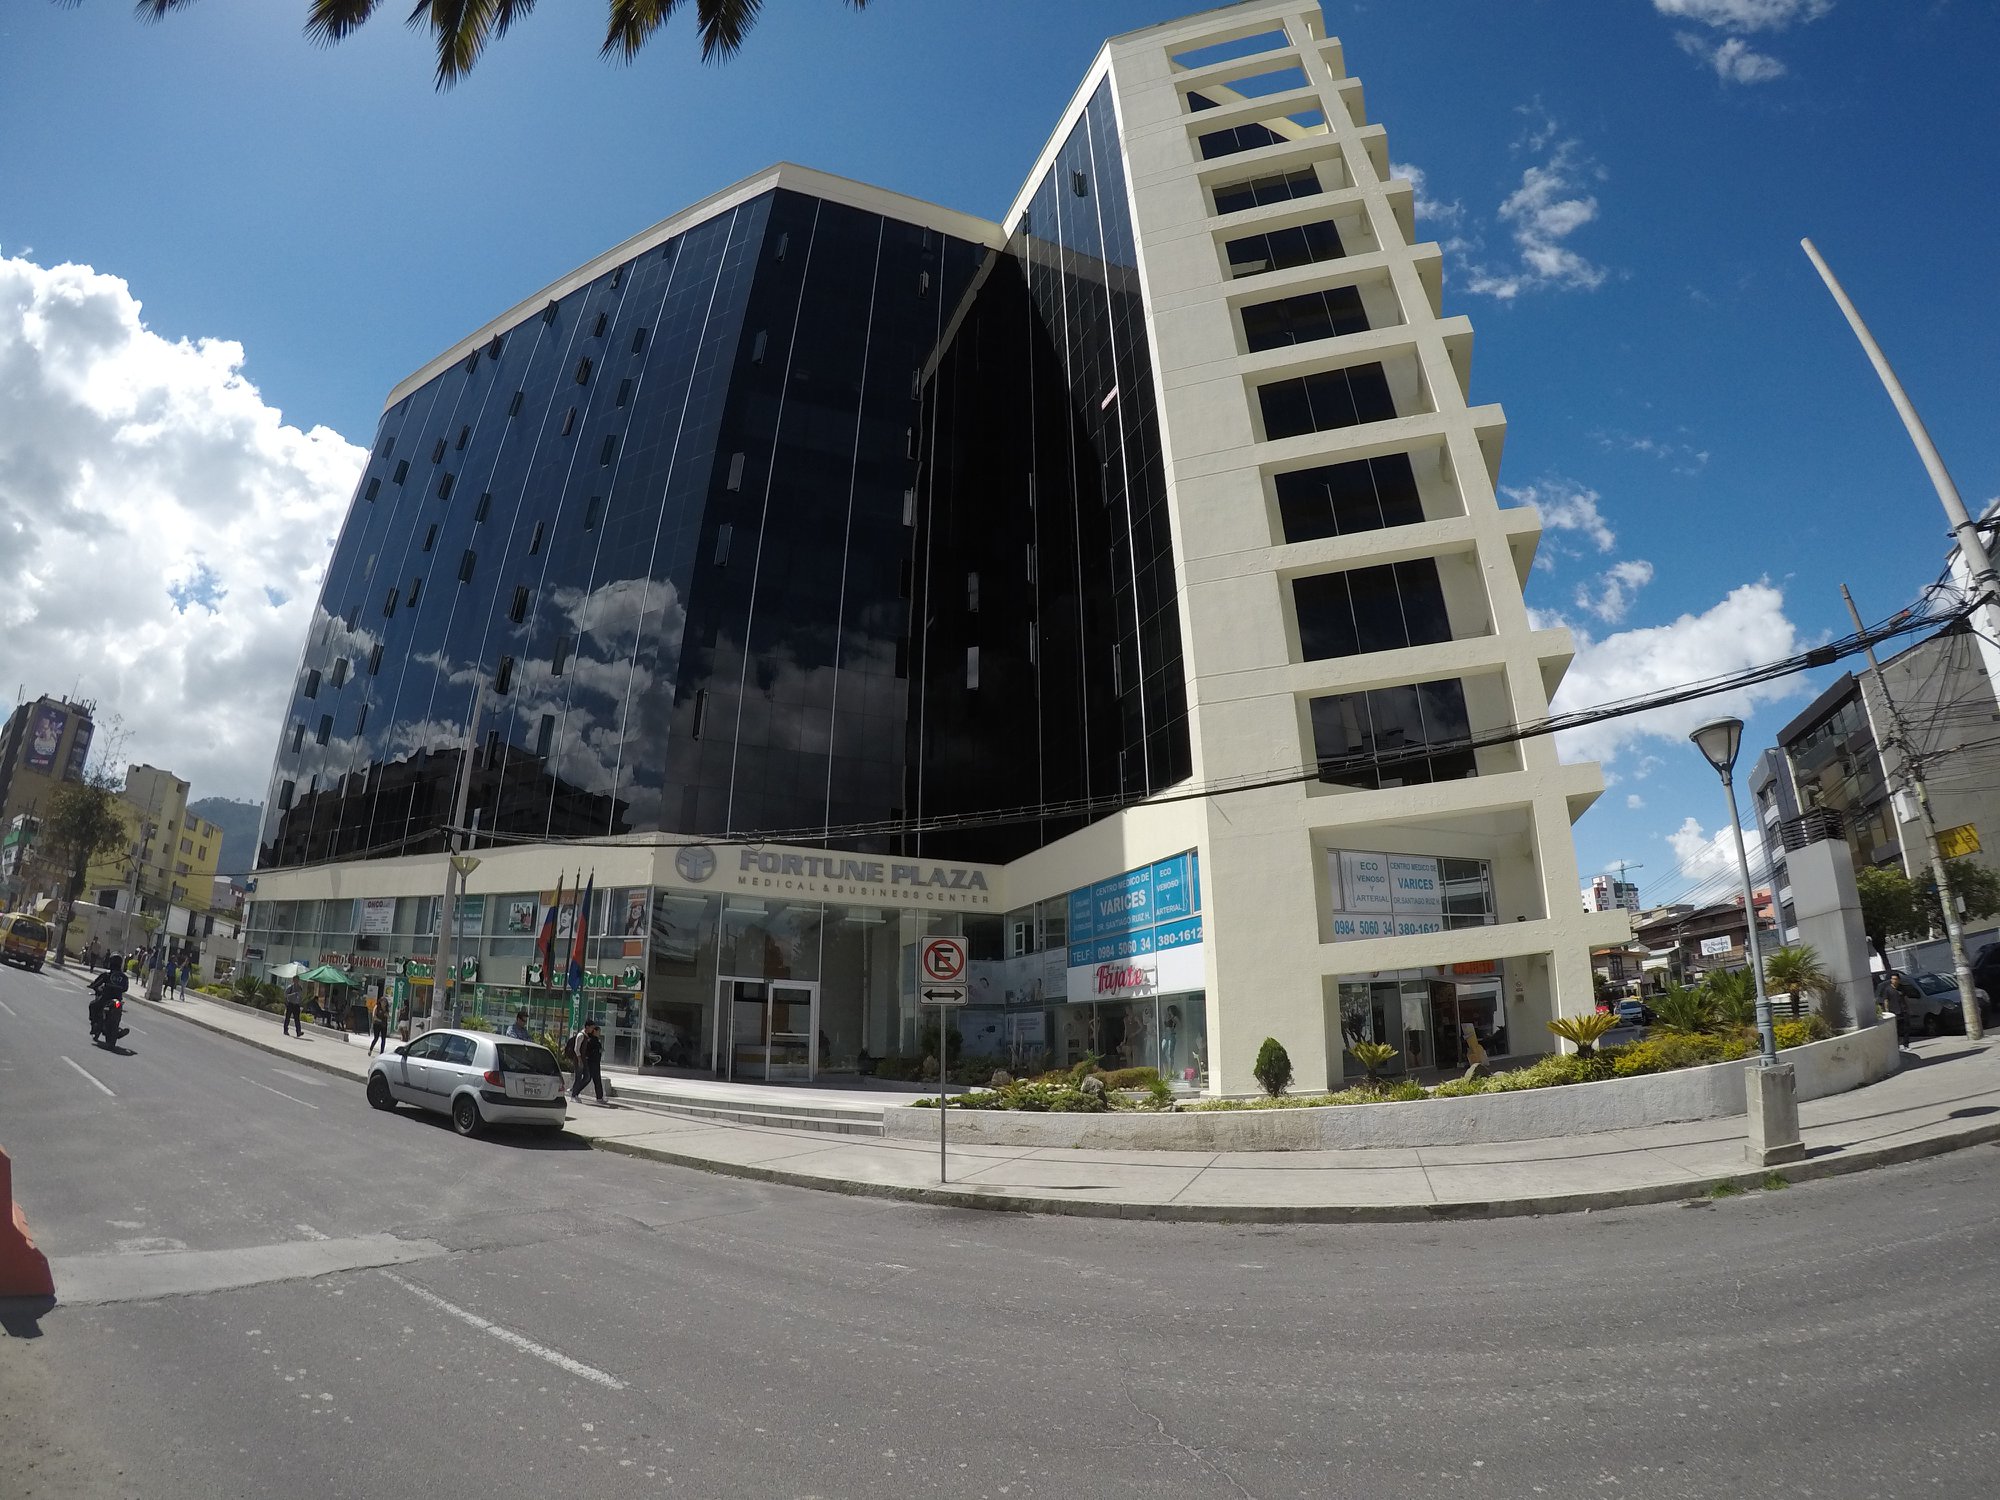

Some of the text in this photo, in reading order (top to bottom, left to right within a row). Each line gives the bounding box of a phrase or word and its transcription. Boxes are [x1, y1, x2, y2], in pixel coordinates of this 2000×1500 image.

[740, 850, 988, 890] FORTUNE PLAZA
[1160, 867, 1171, 877] ECO
[1360, 862, 1378, 871] ECO
[1390, 862, 1410, 870] CENTRO
[1096, 872, 1150, 896] CENTRO MEDICO DE
[1357, 875, 1385, 883] VENOSO
[1398, 878, 1434, 890] VARICES
[738, 876, 989, 904] MEDICAL & BUSINESS CENTER
[1157, 879, 1179, 892] VENOSO
[1101, 889, 1146, 916] VARICES
[1356, 895, 1390, 903] ARTERIAL
[1156, 904, 1182, 916] ARTERIAL
[1131, 913, 1145, 923] RUIZ
[1335, 920, 1440, 935] 0984 5060 34 380-1612
[1098, 944, 1114, 959] 0984
[1119, 939, 1137, 955] 5060
[1140, 936, 1151, 951] 34
[1158, 927, 1203, 946] 380-1612
[934, 947, 954, 973] E
